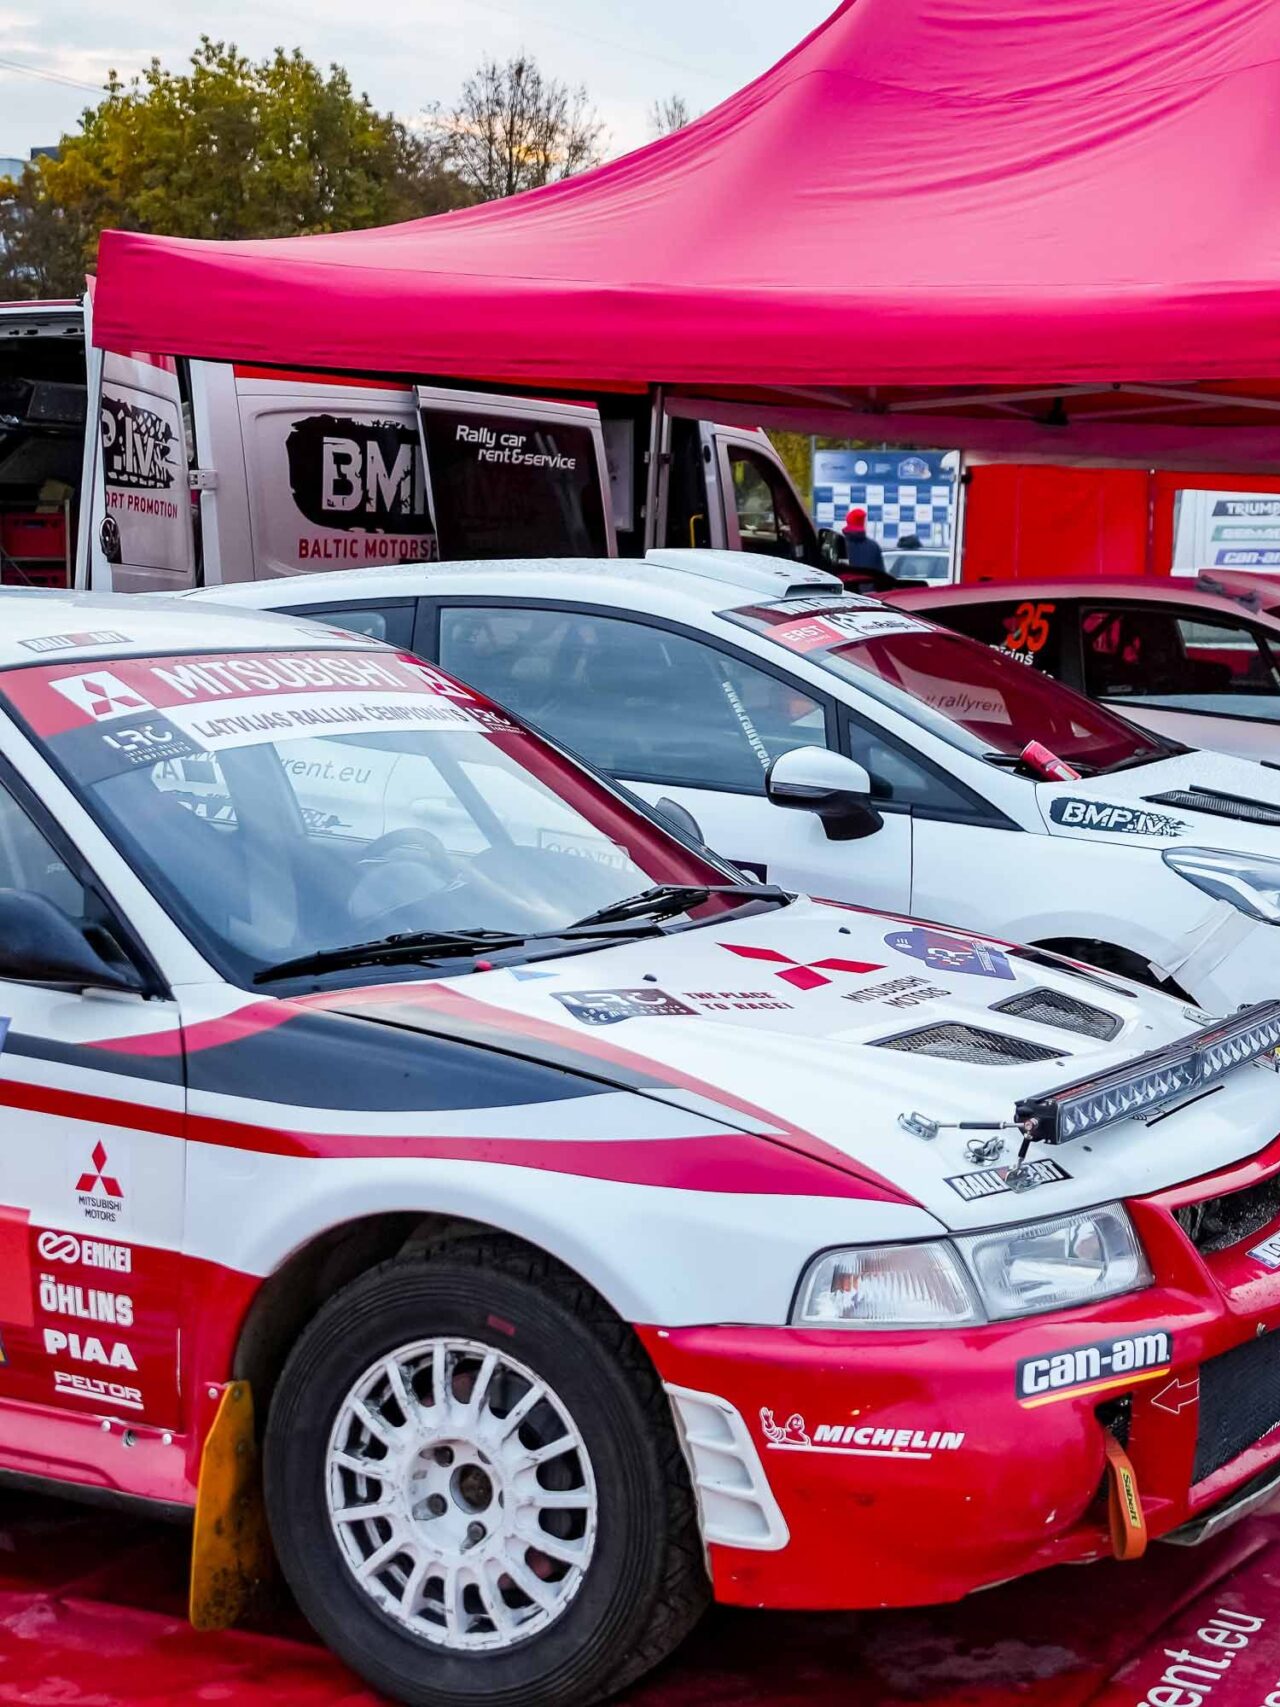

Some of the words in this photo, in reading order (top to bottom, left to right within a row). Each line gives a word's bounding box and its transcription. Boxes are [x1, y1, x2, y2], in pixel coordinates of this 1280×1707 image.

[456, 425, 496, 446] Rally
[500, 433, 526, 447] car
[128, 495, 178, 519] PROMOTION
[299, 537, 360, 559] BALTIC
[1007, 603, 1056, 651] 35
[151, 658, 408, 699] MITSUBISHI
[192, 711, 293, 739] LATVIJAS
[722, 681, 771, 772] www.rallyren
[841, 975, 932, 1003] MITSUBISHI
[882, 987, 952, 1009] MOTORS
[79, 1195, 122, 1212] MITSUBISHI
[85, 1208, 116, 1223] MOTORS
[82, 1240, 132, 1273] ENKEI
[40, 1274, 134, 1327] ÖHLINS
[43, 1328, 138, 1372] PIAA
[1022, 1332, 1168, 1394] can-am
[54, 1371, 142, 1401] PELTOR
[813, 1424, 965, 1450] MICHELIN
[1136, 1608, 1266, 1707] ent.eu
